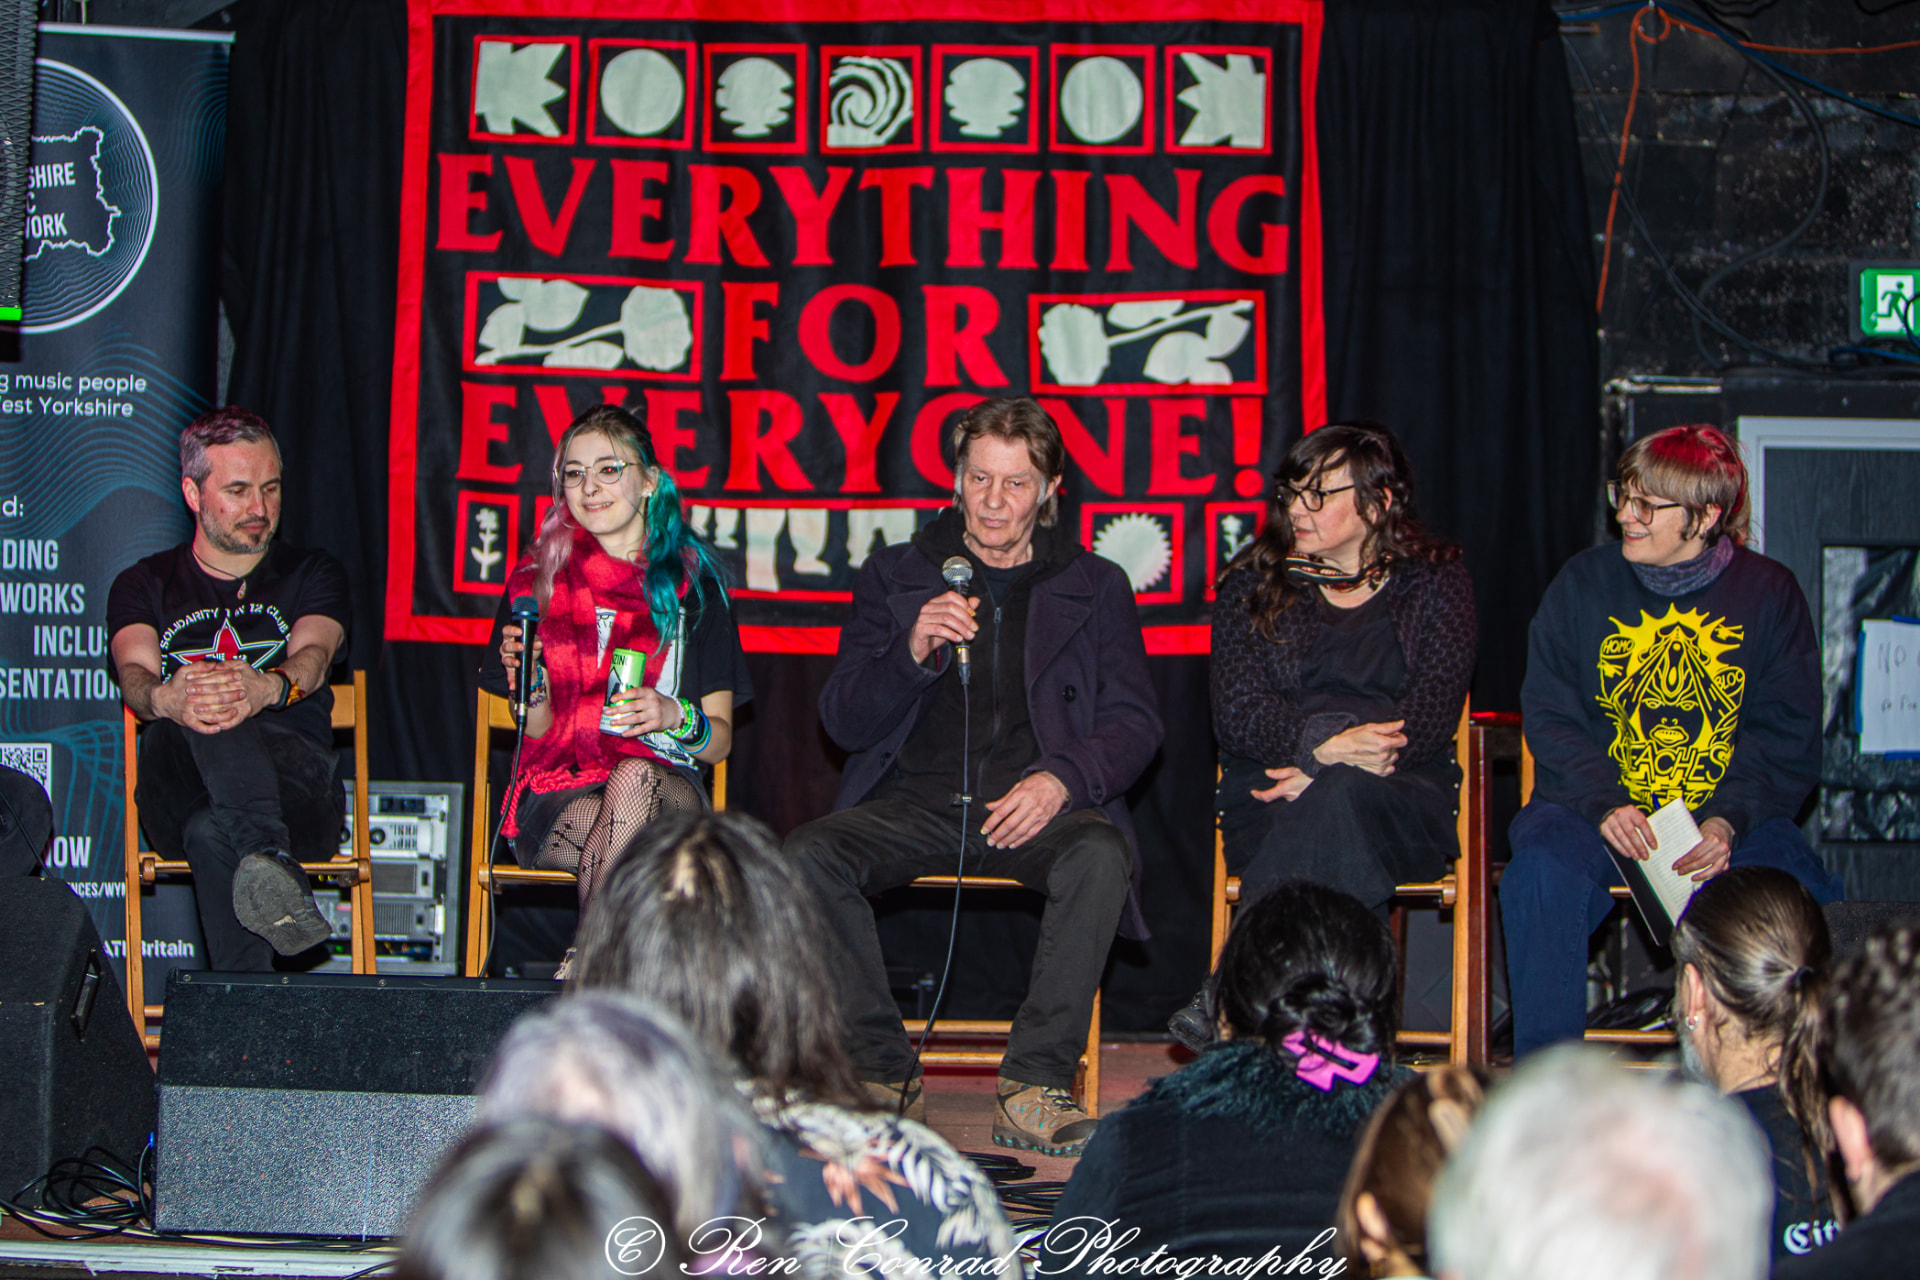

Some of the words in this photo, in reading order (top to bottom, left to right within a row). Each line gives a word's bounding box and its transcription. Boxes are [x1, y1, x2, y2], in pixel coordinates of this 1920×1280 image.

[25, 212, 68, 239] ORK
[437, 153, 1289, 274] EVERYTHING
[720, 281, 1009, 388] FOR
[15, 371, 73, 391] music
[78, 373, 147, 396] people
[0, 395, 33, 415] est
[38, 396, 134, 417] Yorkshire
[455, 380, 1264, 497] EVERYONE!
[33, 625, 108, 658] INCLU
[160, 607, 219, 650] SOLIDARITY
[249, 603, 264, 615] 12
[266, 605, 290, 634] CLUB
[1603, 639, 1634, 655] HOMO
[45, 836, 91, 868] OW
